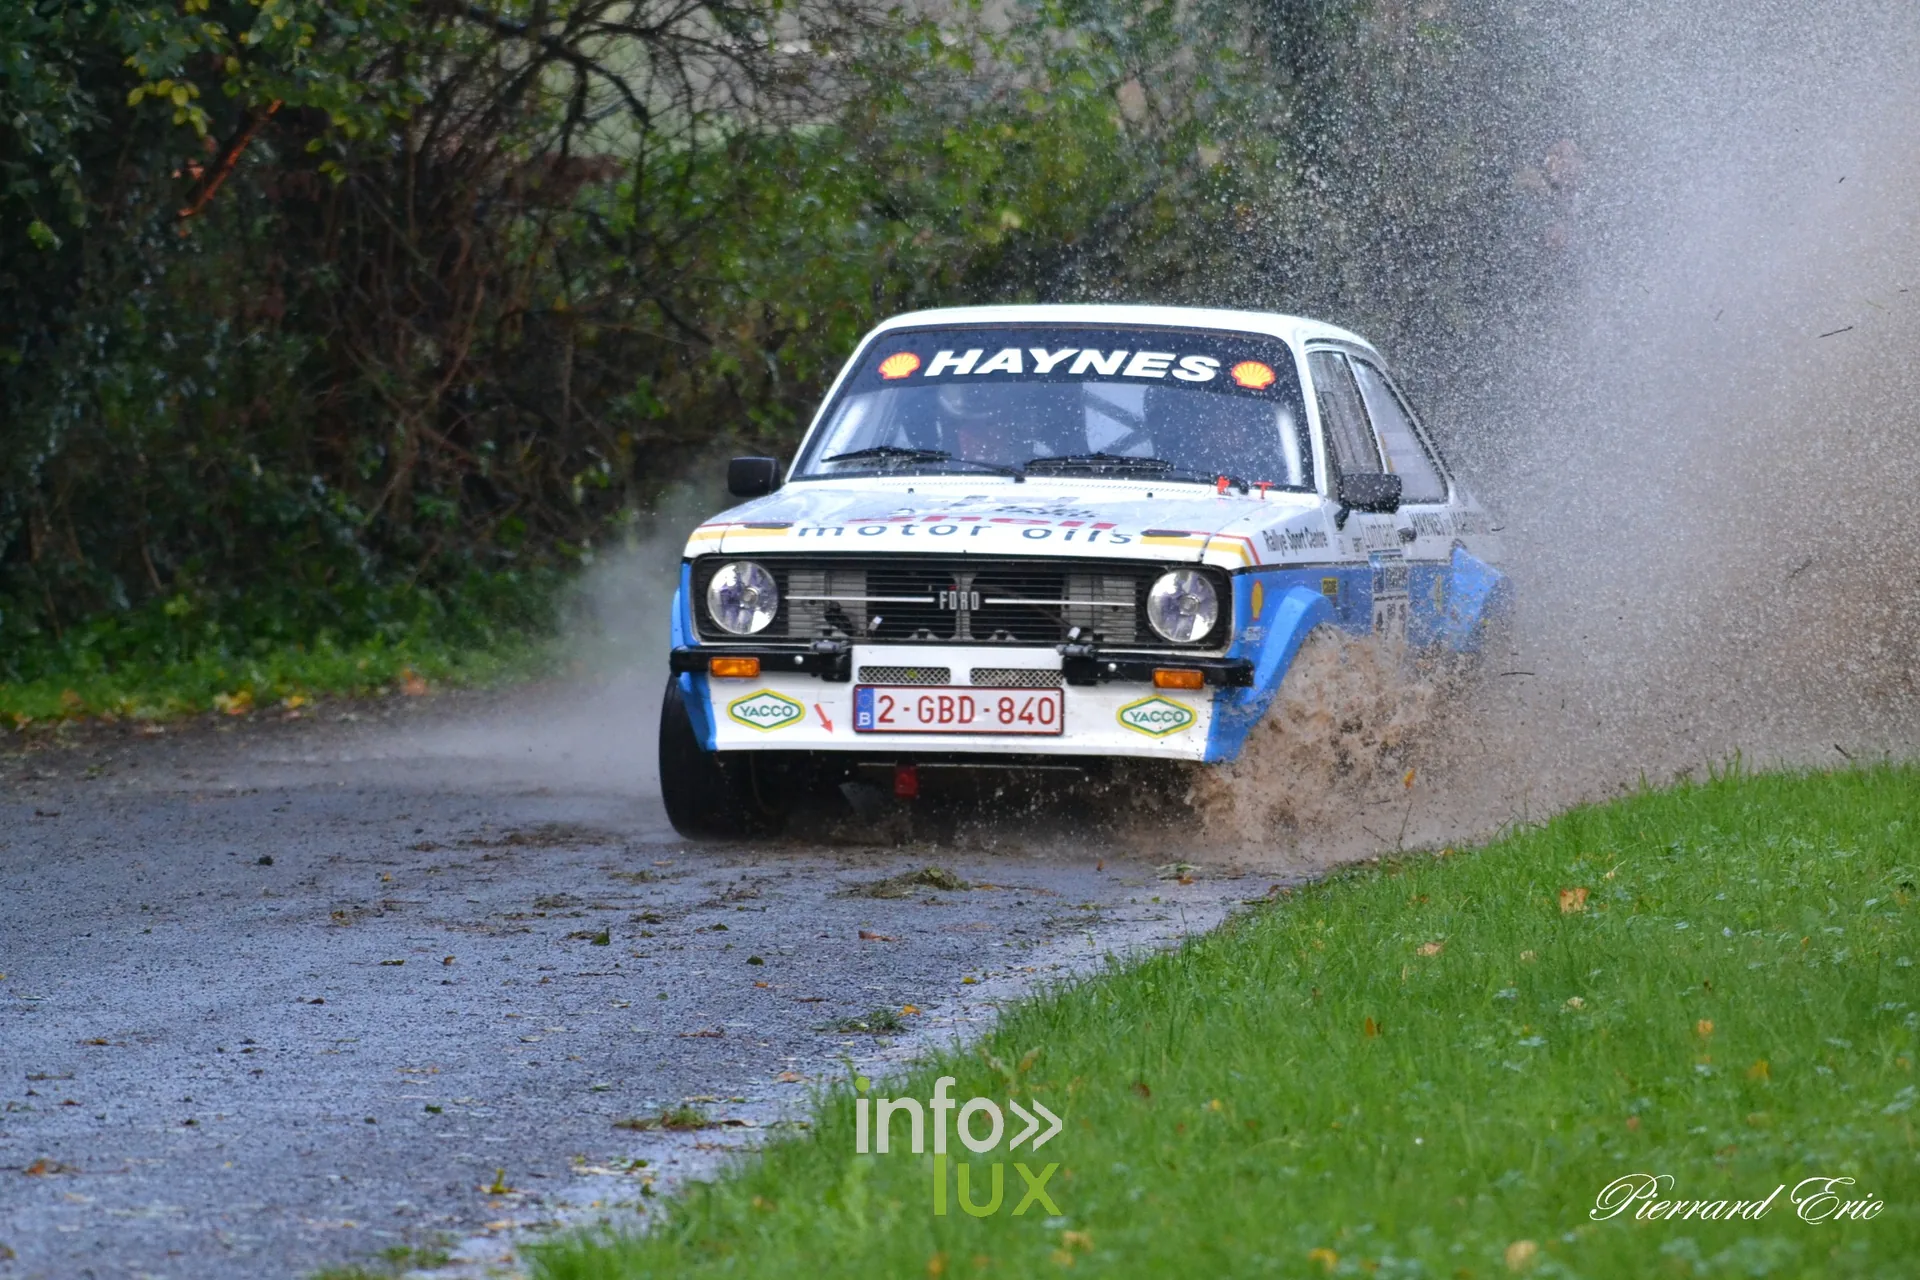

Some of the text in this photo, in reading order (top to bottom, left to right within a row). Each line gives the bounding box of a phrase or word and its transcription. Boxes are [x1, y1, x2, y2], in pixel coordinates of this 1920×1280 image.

[924, 348, 1221, 383] HAYNES
[797, 523, 1133, 545] motor oils
[939, 590, 980, 611] FORD
[740, 704, 793, 718] YACCO
[858, 711, 872, 726] B
[1129, 710, 1185, 723] YACCO
